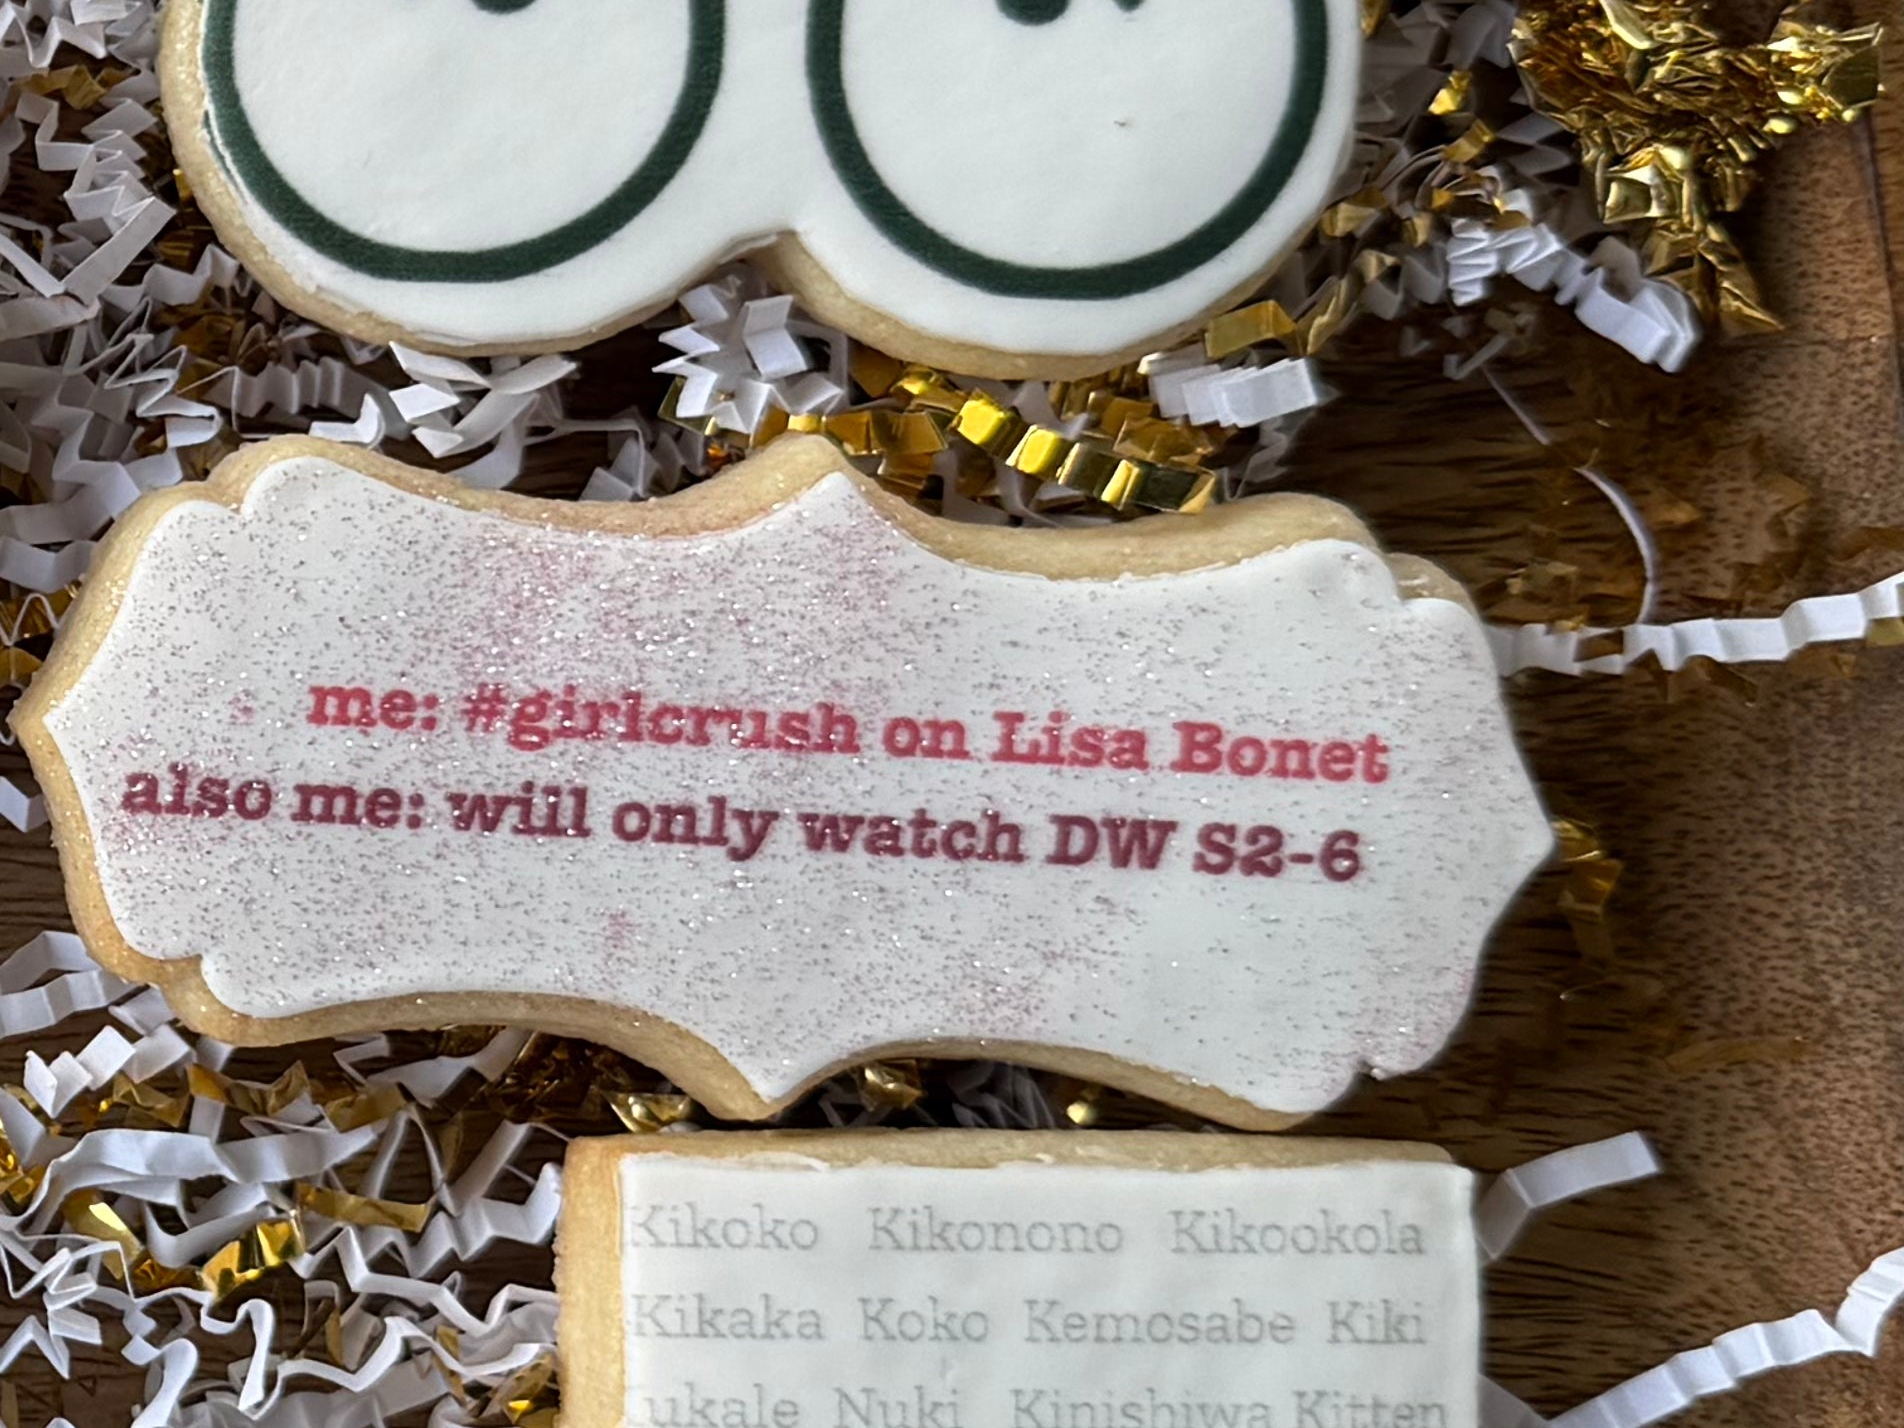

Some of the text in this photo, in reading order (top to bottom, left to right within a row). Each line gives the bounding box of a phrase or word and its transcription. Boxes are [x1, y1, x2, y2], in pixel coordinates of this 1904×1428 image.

[307, 683, 1390, 783] me: #girlcrush on Lisa Bonet
[120, 763, 1361, 883] also me: will only watch DW S2-6
[630, 1202, 1425, 1255] Kikoko Kikonono Kikookola
[631, 1293, 1426, 1345] Kikaka Koko Kemosabe Kiki
